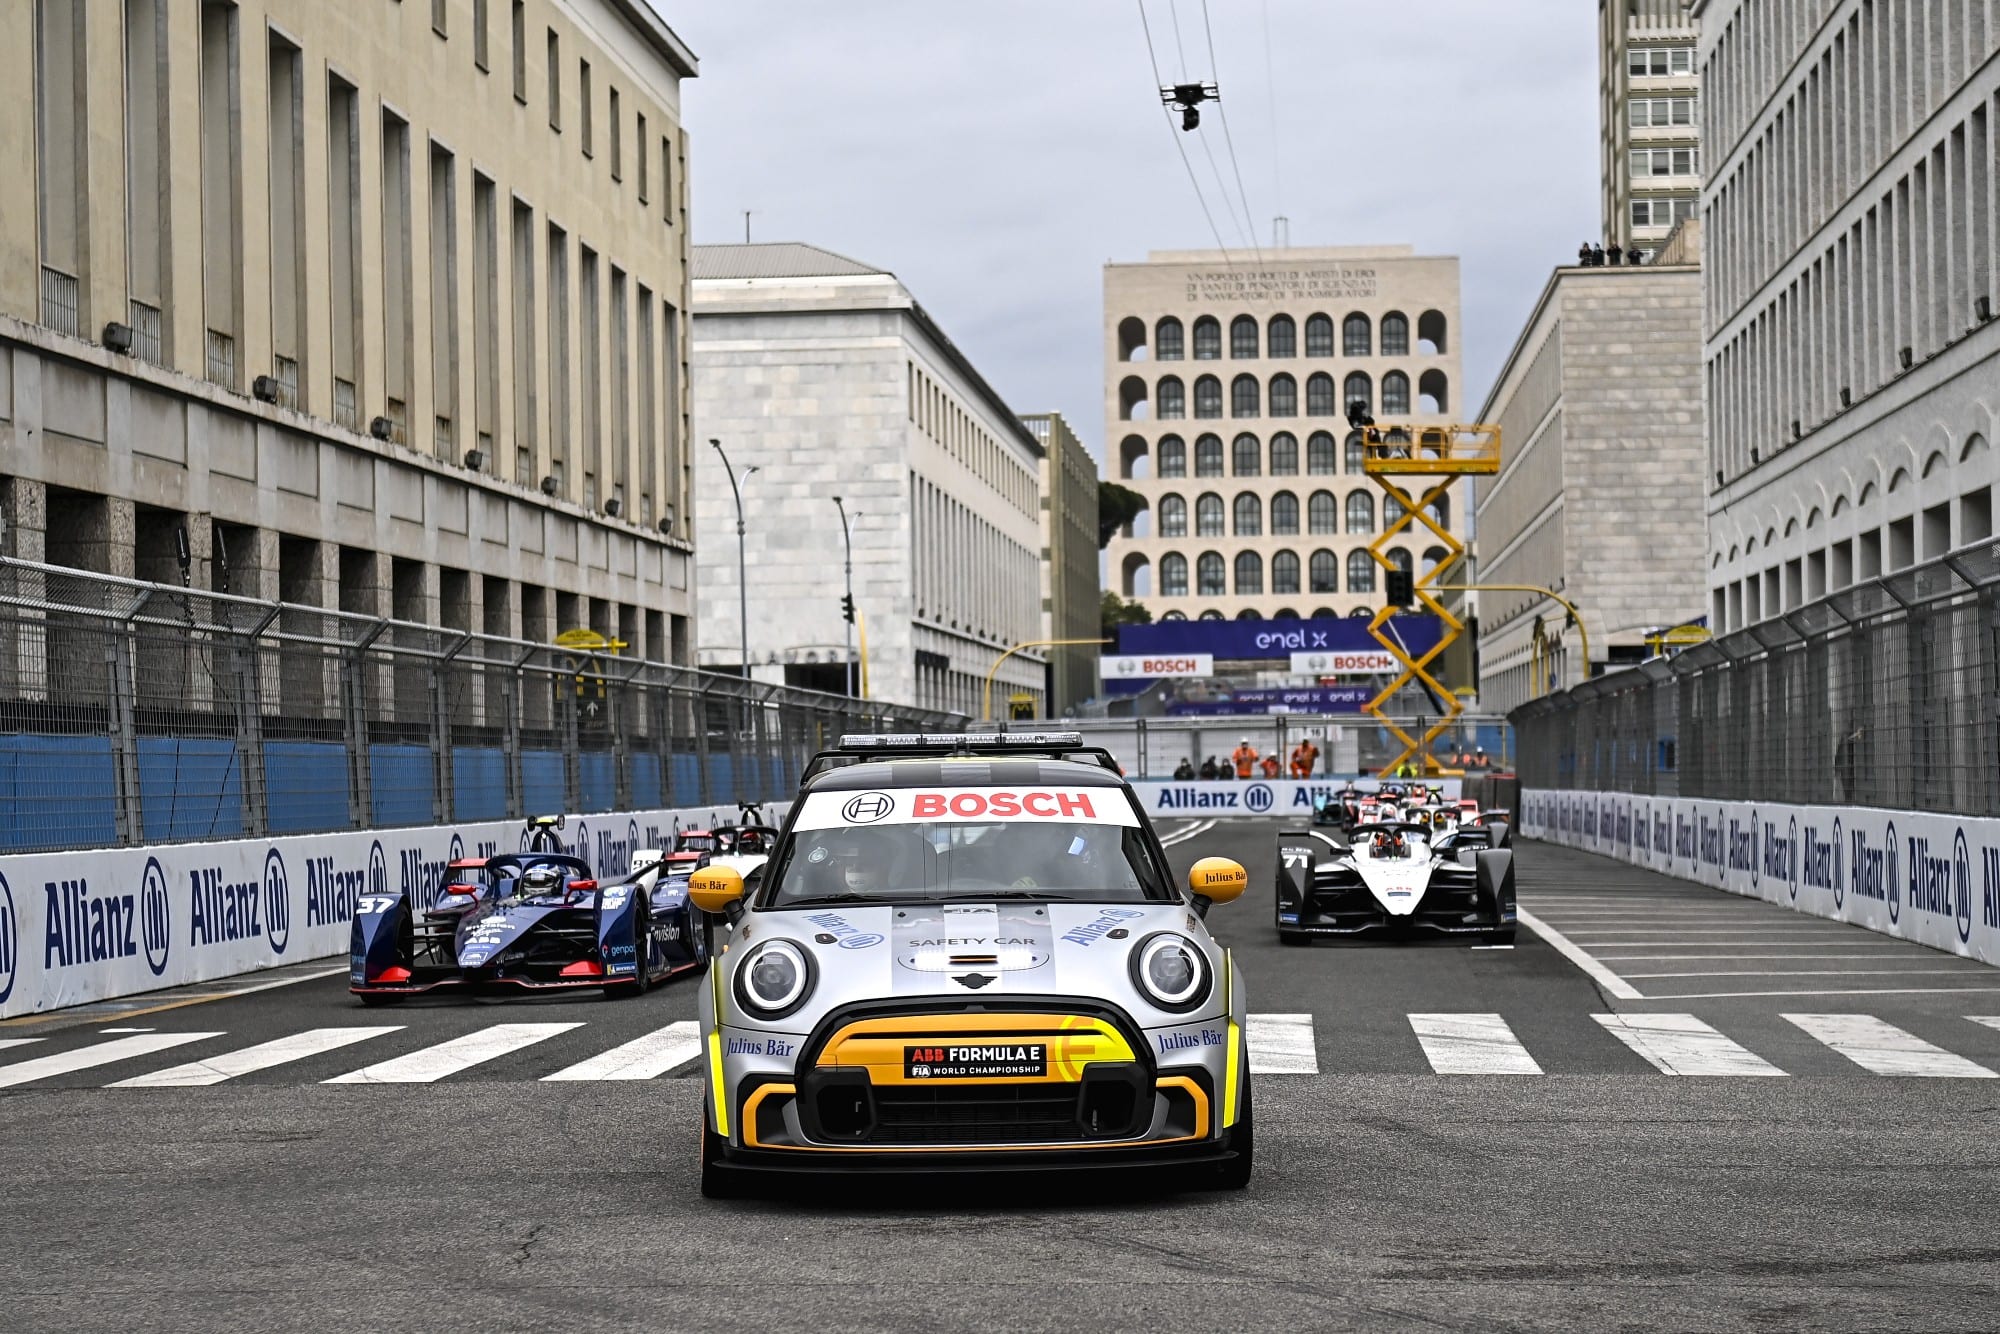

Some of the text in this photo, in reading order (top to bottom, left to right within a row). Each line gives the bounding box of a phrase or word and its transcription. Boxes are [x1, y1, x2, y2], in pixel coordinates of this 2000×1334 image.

[1256, 629, 1306, 649] enel
[1143, 660, 1196, 673] BOSCH
[1334, 656, 1388, 669] BOSCH
[1284, 692, 1310, 703] enel
[1329, 691, 1355, 702] enel
[912, 792, 1097, 818] BOSCH
[1158, 788, 1238, 808] Allianz
[598, 829, 627, 879] Allianz
[1729, 819, 1750, 871] Allianz
[1764, 822, 1787, 881] Allianz
[1283, 855, 1308, 868] 71
[1804, 827, 1831, 889] Allianz
[1852, 829, 1884, 901] Allianz
[709, 881, 728, 890] Bär
[1205, 872, 1233, 884] Julius
[1909, 837, 1952, 917] Allianz
[190, 866, 261, 947] Allianz
[356, 897, 394, 914] 37
[45, 878, 137, 969] Allianz
[802, 913, 859, 936] Allianz
[1061, 917, 1124, 947] Allianz
[909, 937, 986, 947] SAFETY
[726, 1038, 794, 1057] Julius Bär
[1158, 1029, 1222, 1054] Julius Bär
[912, 1046, 1040, 1062] ABB FORMULA E
[912, 1065, 1041, 1076] FIA WORLD CHAMPIONSHIP
